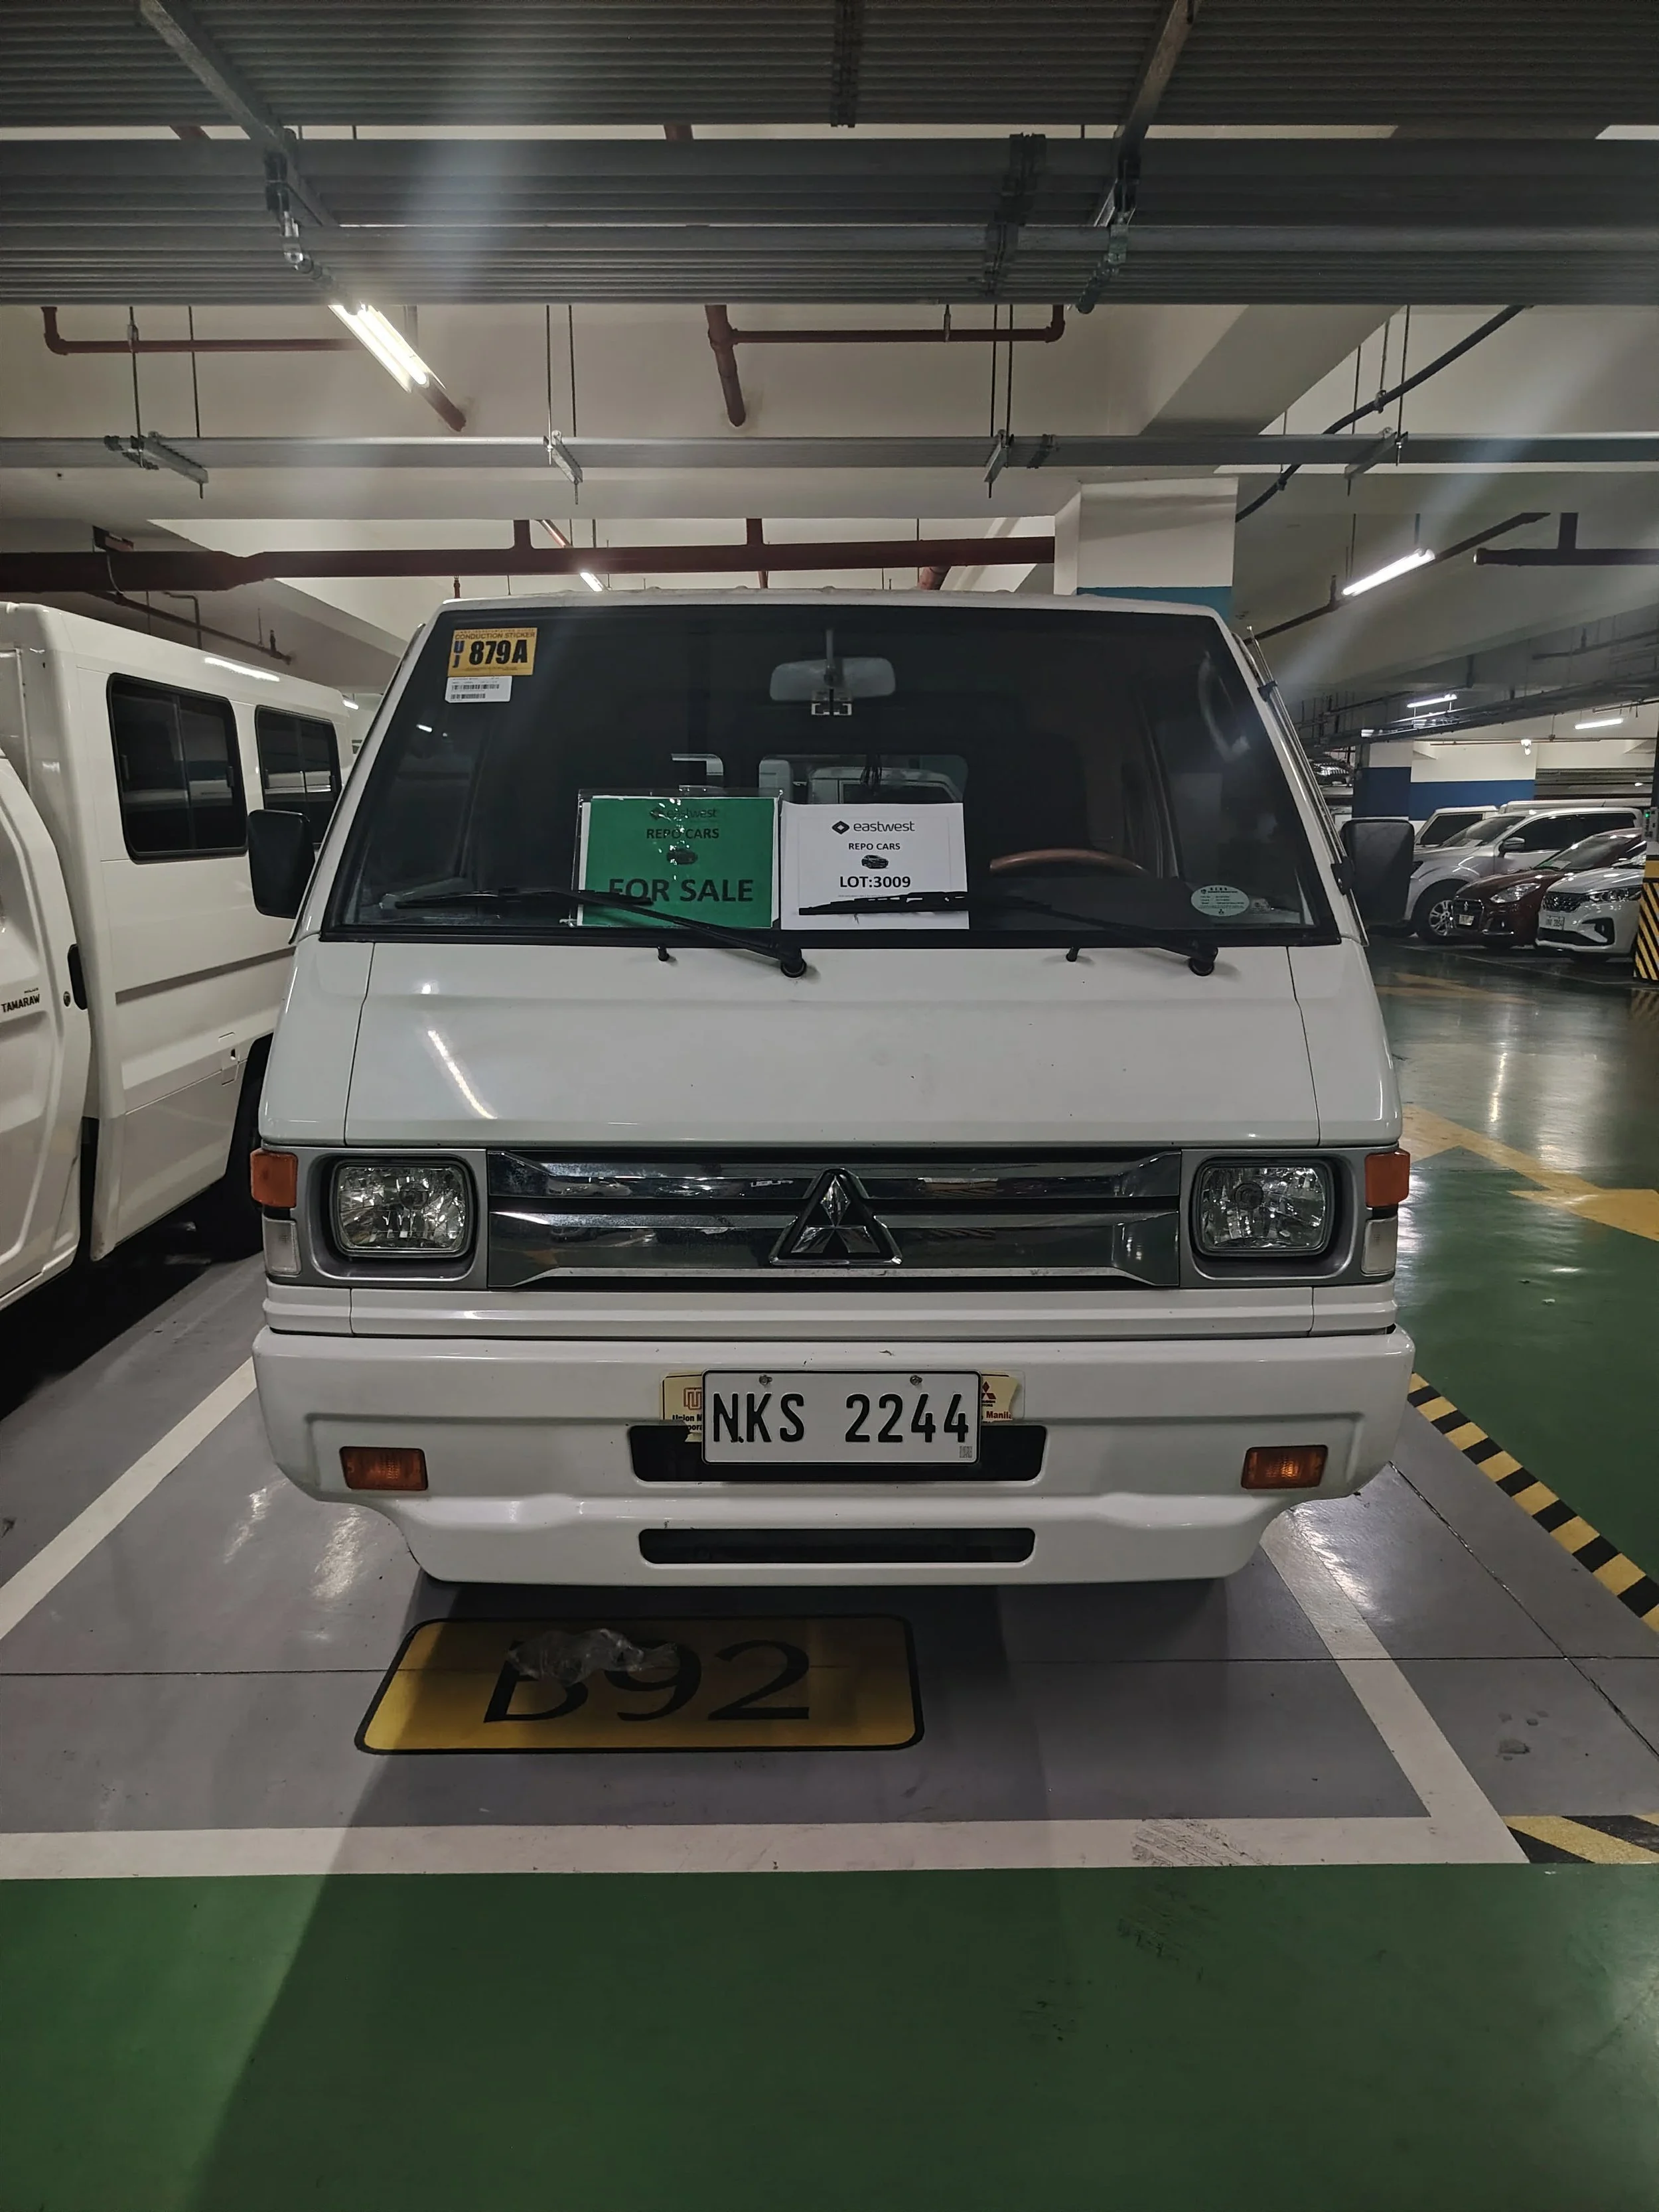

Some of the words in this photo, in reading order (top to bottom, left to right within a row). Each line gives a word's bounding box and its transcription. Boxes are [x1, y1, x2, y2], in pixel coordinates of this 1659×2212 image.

[469, 639, 528, 665] 879A
[646, 828, 681, 839] REPO
[685, 828, 719, 839] CARS
[853, 821, 915, 832] eastwest
[609, 879, 670, 902] FOR
[680, 879, 754, 903] SALE
[839, 876, 911, 888] LOT:3009
[1, 994, 40, 1013] TAMARAW
[713, 1392, 805, 1443] NKS
[845, 1392, 969, 1443] 2244
